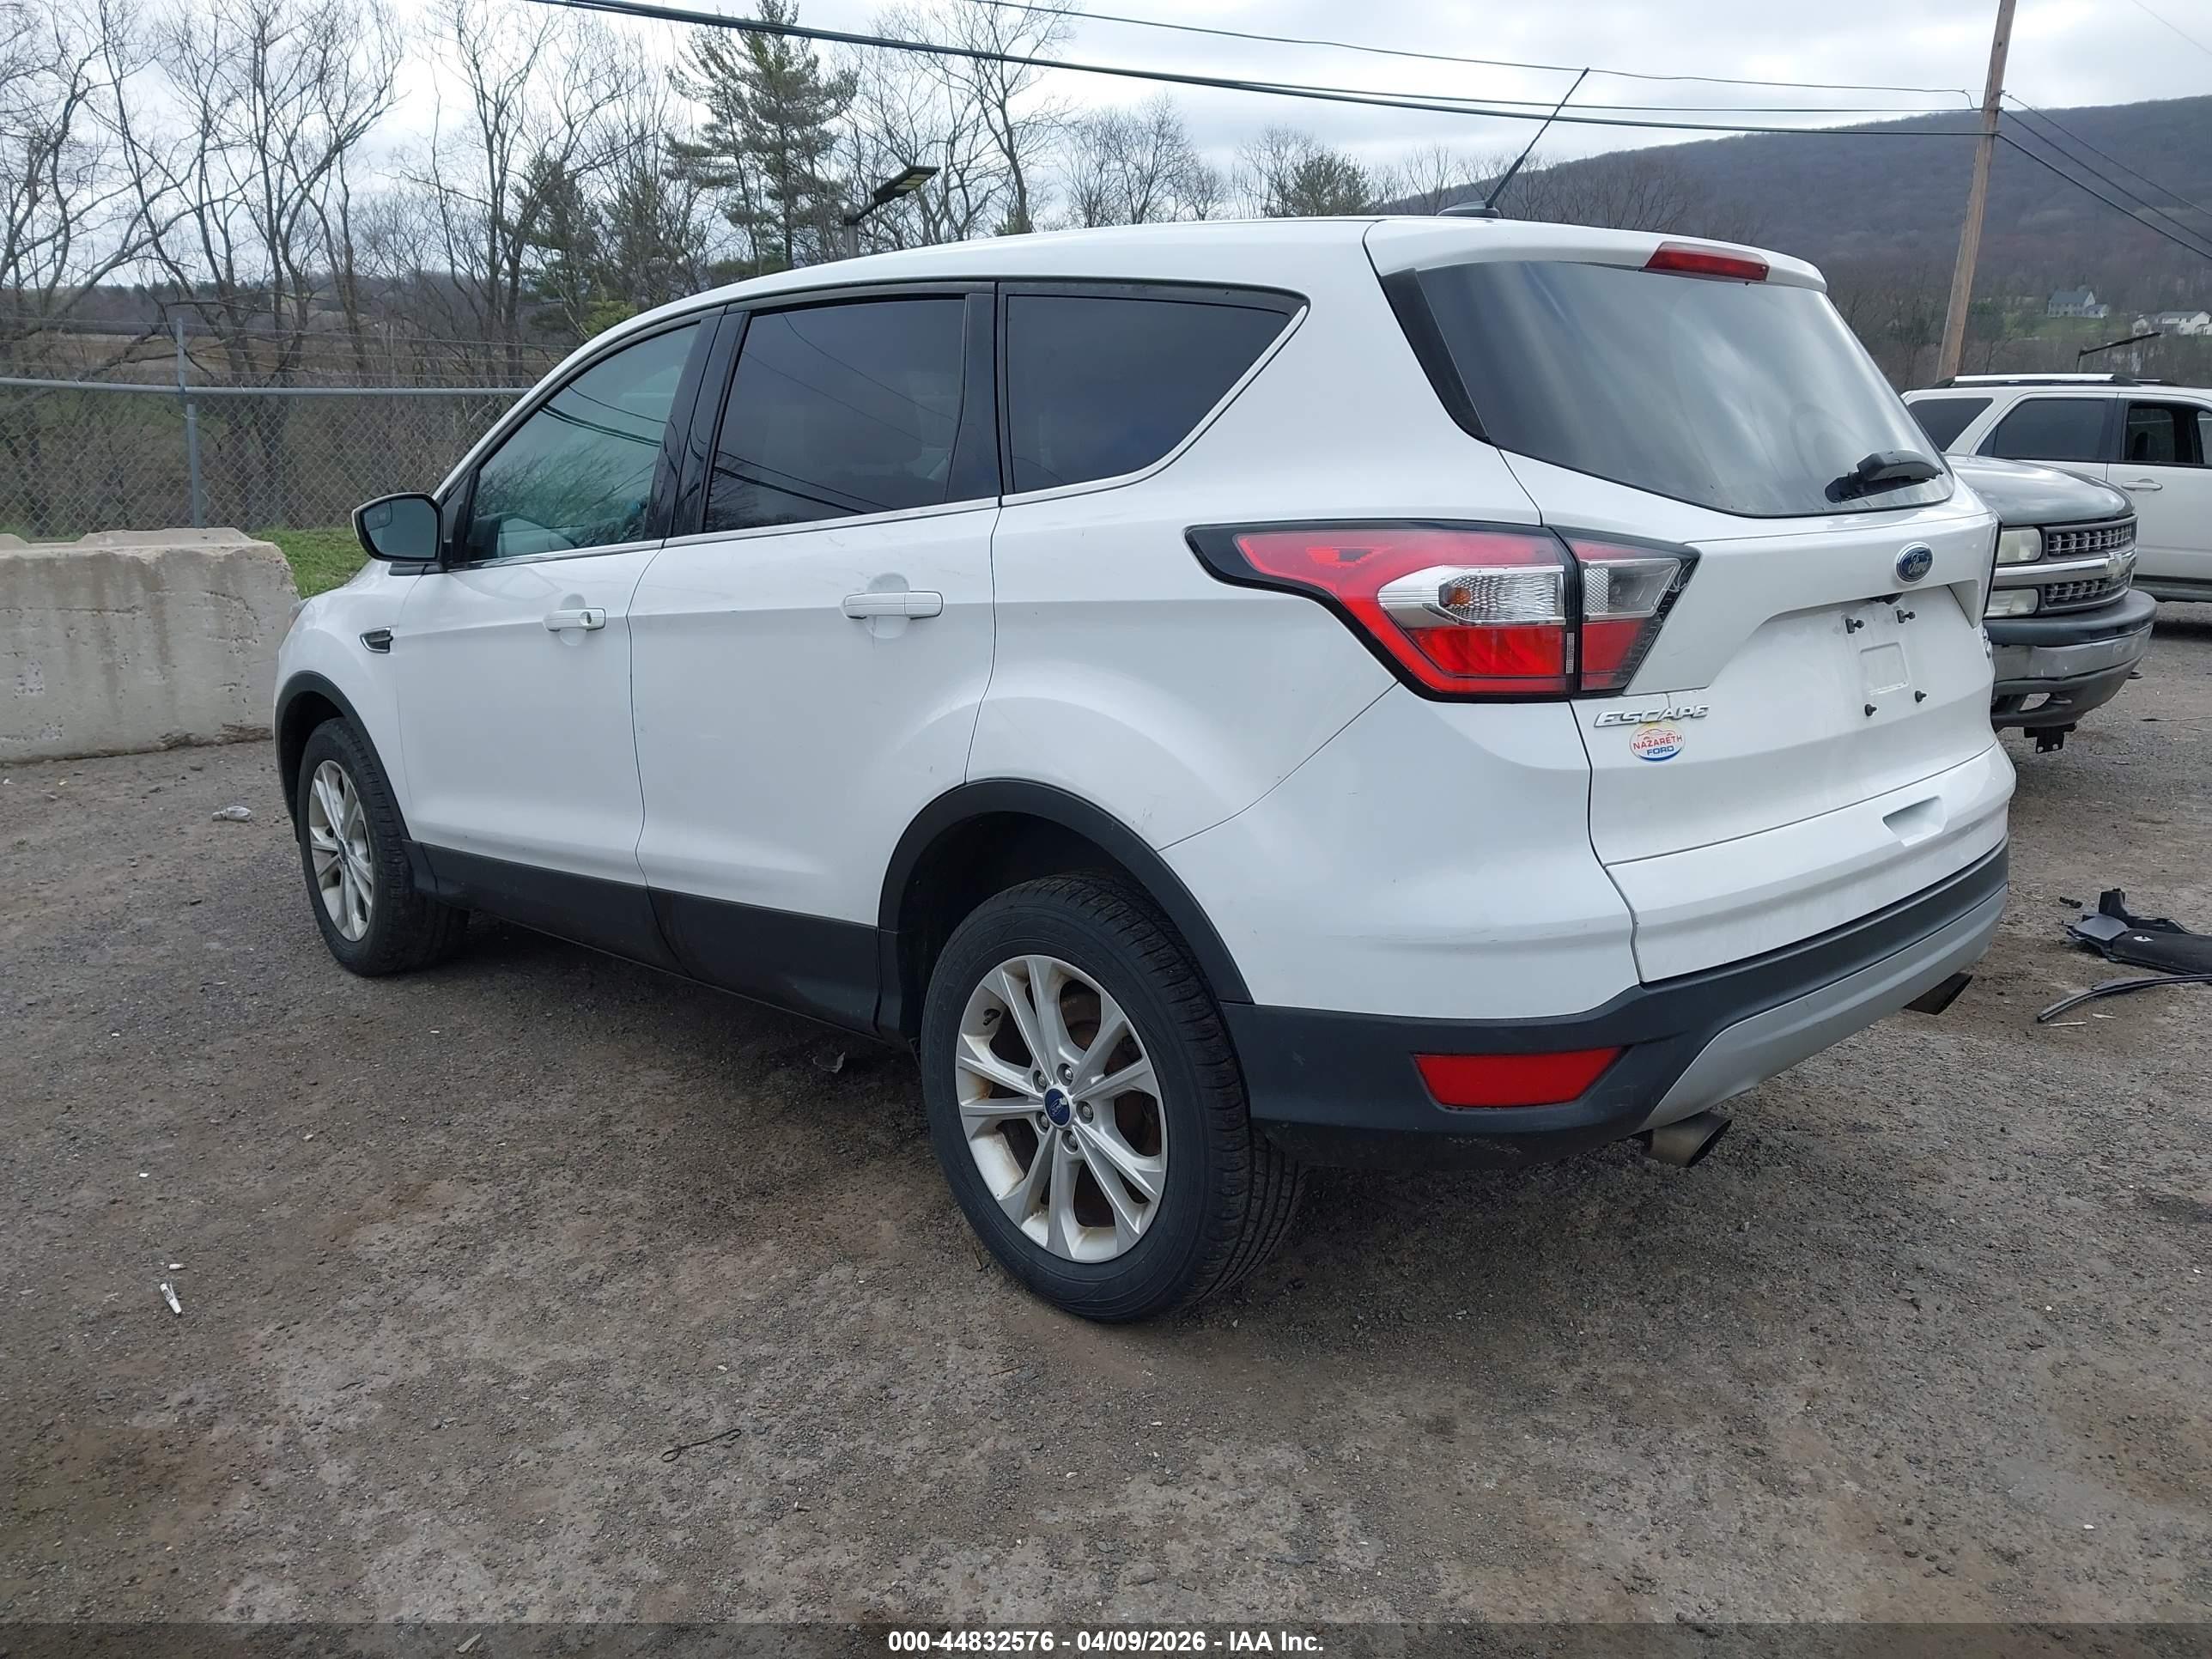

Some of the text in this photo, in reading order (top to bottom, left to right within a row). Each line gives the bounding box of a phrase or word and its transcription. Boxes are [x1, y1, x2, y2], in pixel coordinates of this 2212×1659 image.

[1595, 704, 1711, 727] ESCAPE
[1632, 734, 1683, 750] NAZARETH
[1647, 745, 1674, 756] FORD
